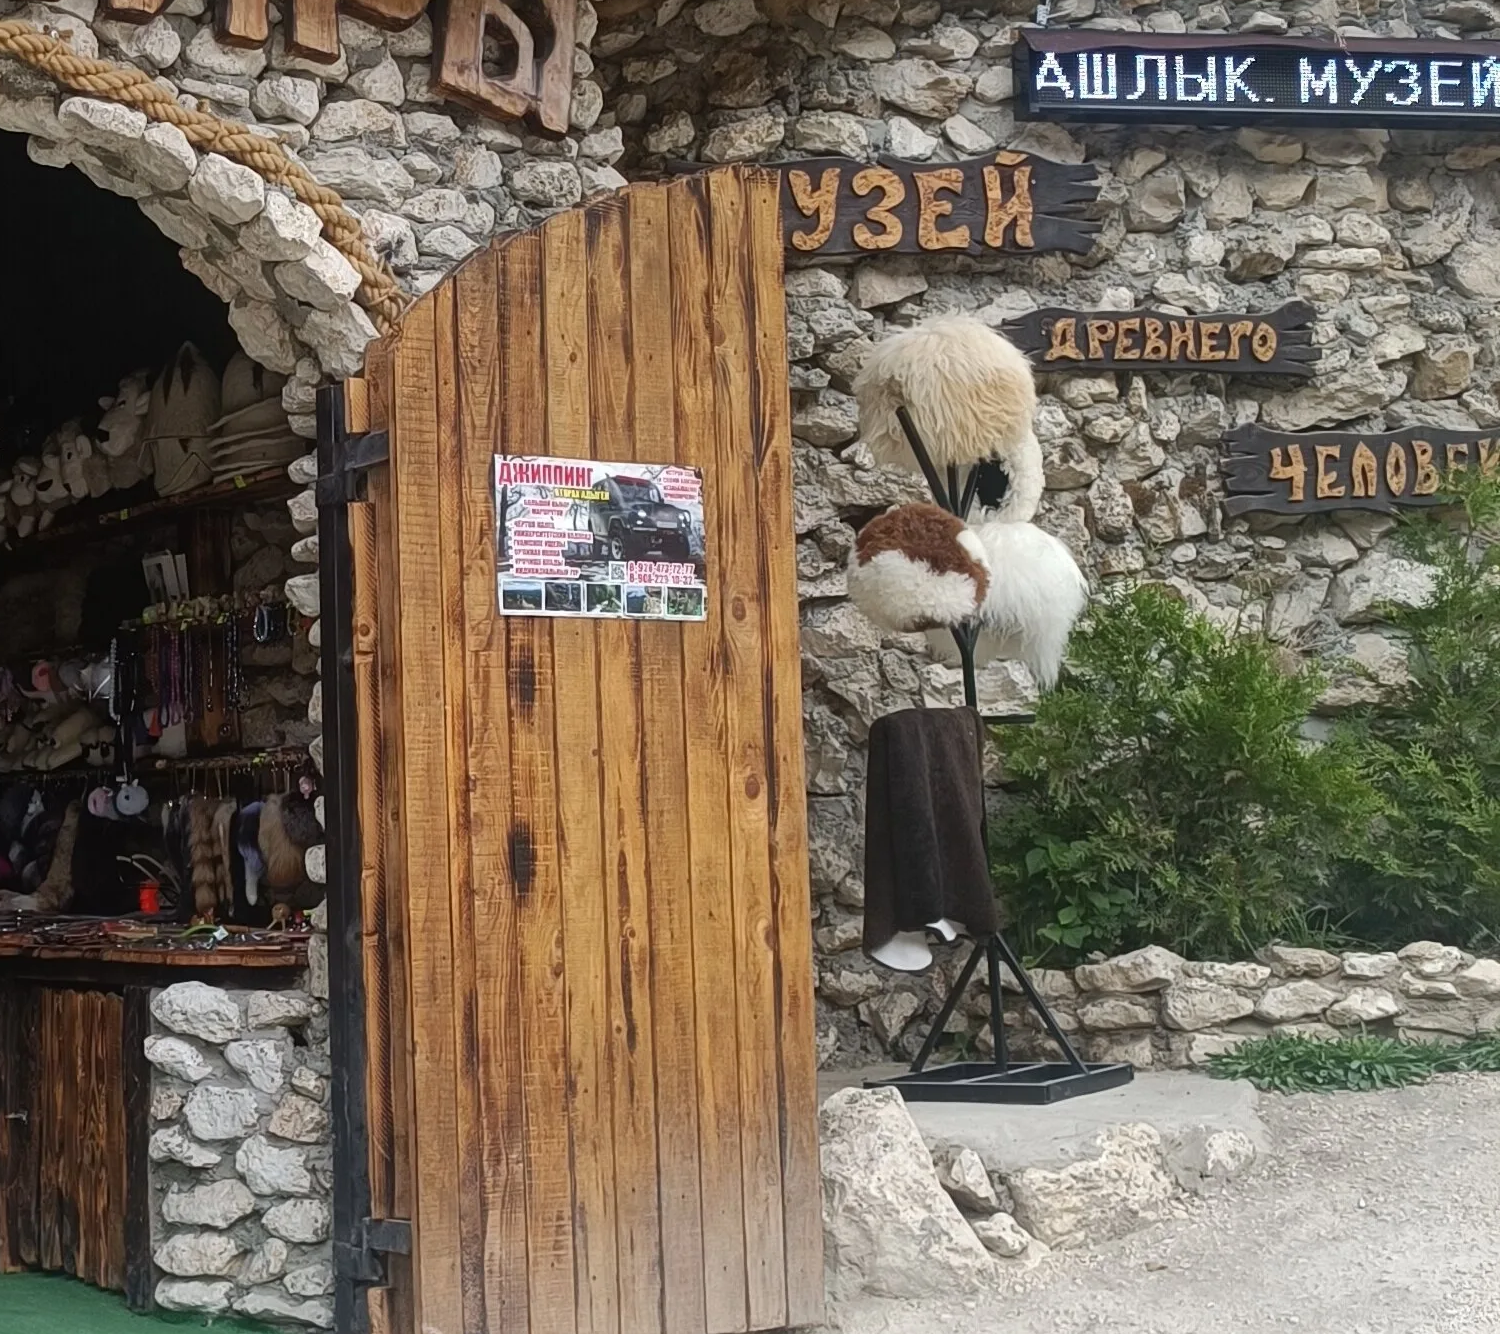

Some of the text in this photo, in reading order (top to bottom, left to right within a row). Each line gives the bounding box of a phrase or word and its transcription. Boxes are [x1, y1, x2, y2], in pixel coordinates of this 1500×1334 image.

[788, 150, 1035, 253] УЗЕЙ
[1043, 316, 1278, 364] ДРЕВНЕГО
[499, 462, 594, 488] ДЖИППИНГ
